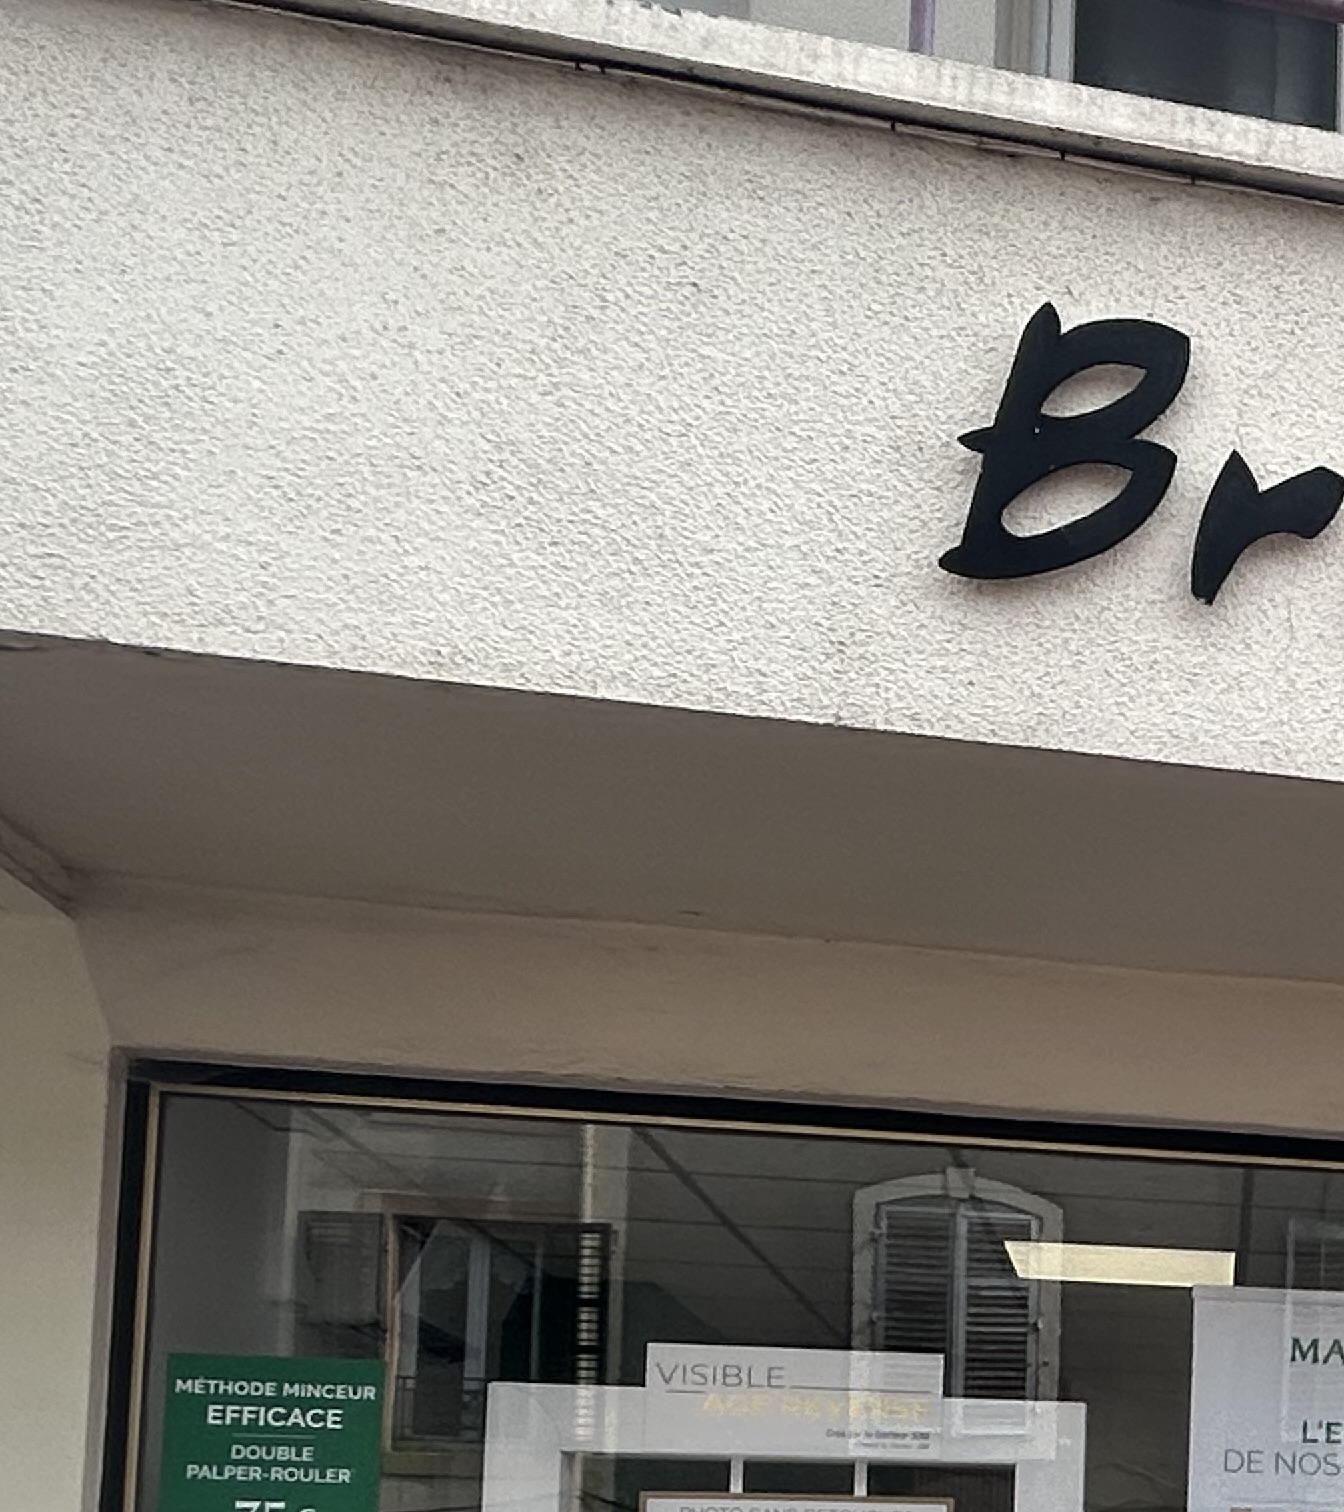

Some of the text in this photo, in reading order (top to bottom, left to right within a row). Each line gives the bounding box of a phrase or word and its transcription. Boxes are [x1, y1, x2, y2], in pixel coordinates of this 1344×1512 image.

[656, 1362, 786, 1388] VISIBLE
[174, 1376, 376, 1400] MÉTHODE MINCEUR
[206, 1405, 343, 1429] EFFICACE
[230, 1445, 314, 1461] DOUBLE
[1223, 1449, 1263, 1474] DE
[1275, 1451, 1341, 1476] NOS
[186, 1465, 352, 1484] PALPER-ROULER
